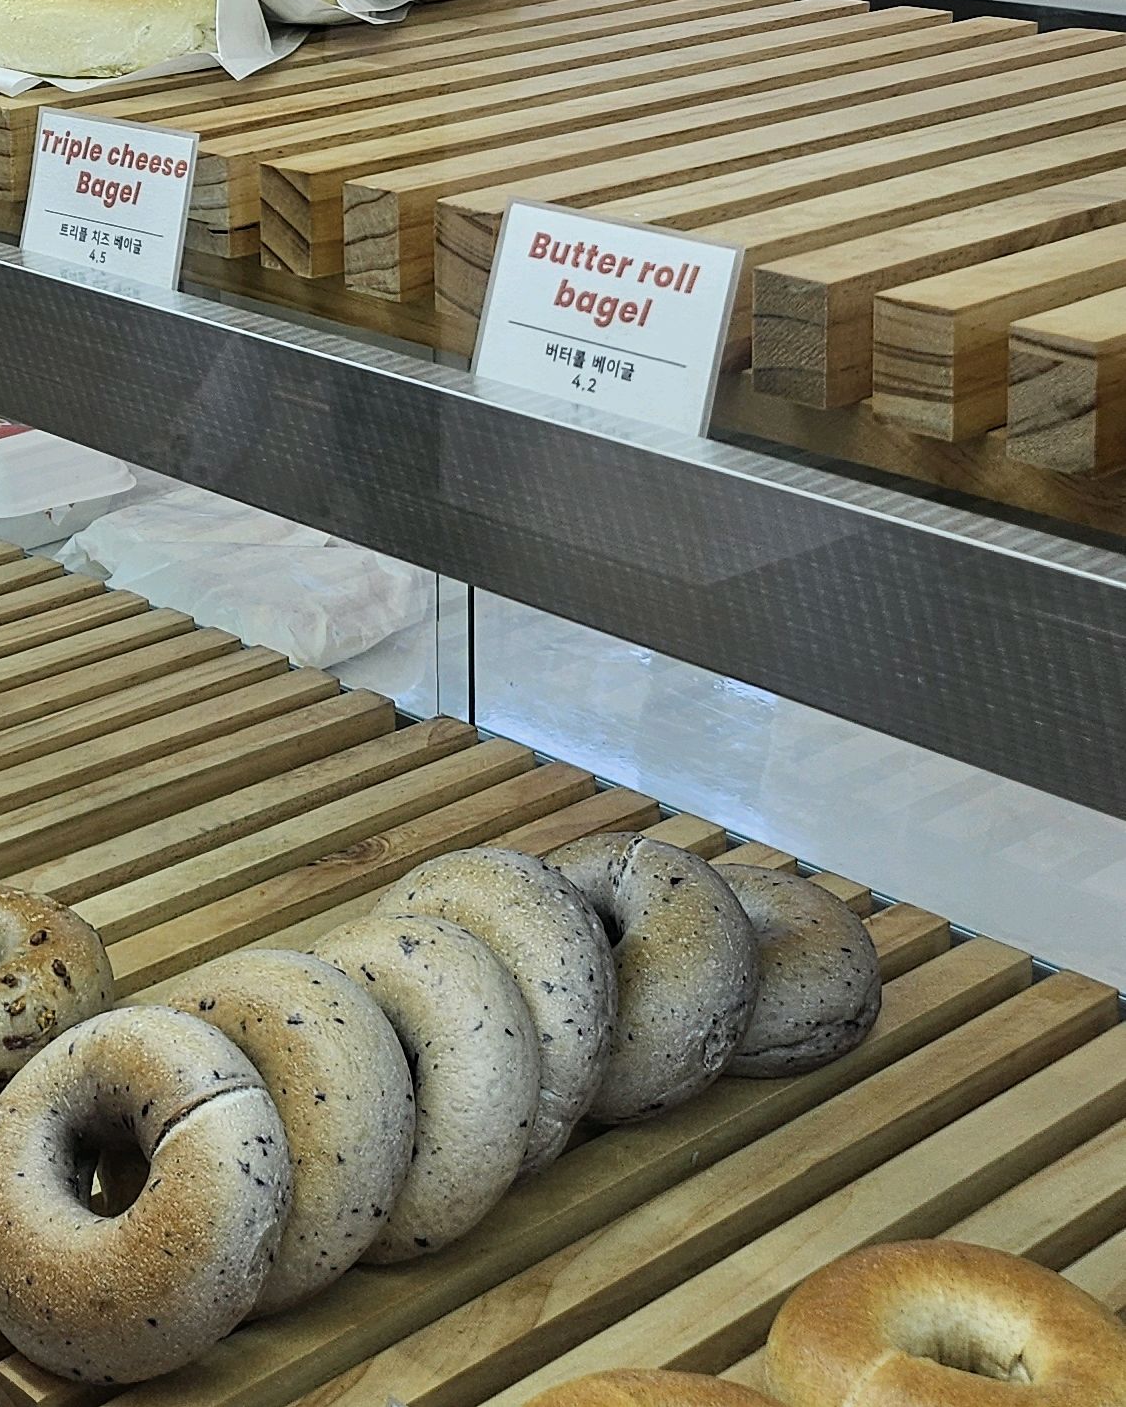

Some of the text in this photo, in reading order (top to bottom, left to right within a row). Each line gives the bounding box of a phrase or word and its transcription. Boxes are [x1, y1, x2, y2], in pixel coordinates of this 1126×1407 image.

[41, 129, 188, 178] Triple cheese
[76, 170, 142, 208] Bagel
[59, 223, 142, 255] 트리플 치즈 베이글
[89, 249, 106, 264] 4.5
[528, 231, 701, 294] Butter roll
[553, 279, 653, 328] bagel
[545, 343, 635, 382] 버터롤 베이글
[571, 374, 597, 393] 4.2
